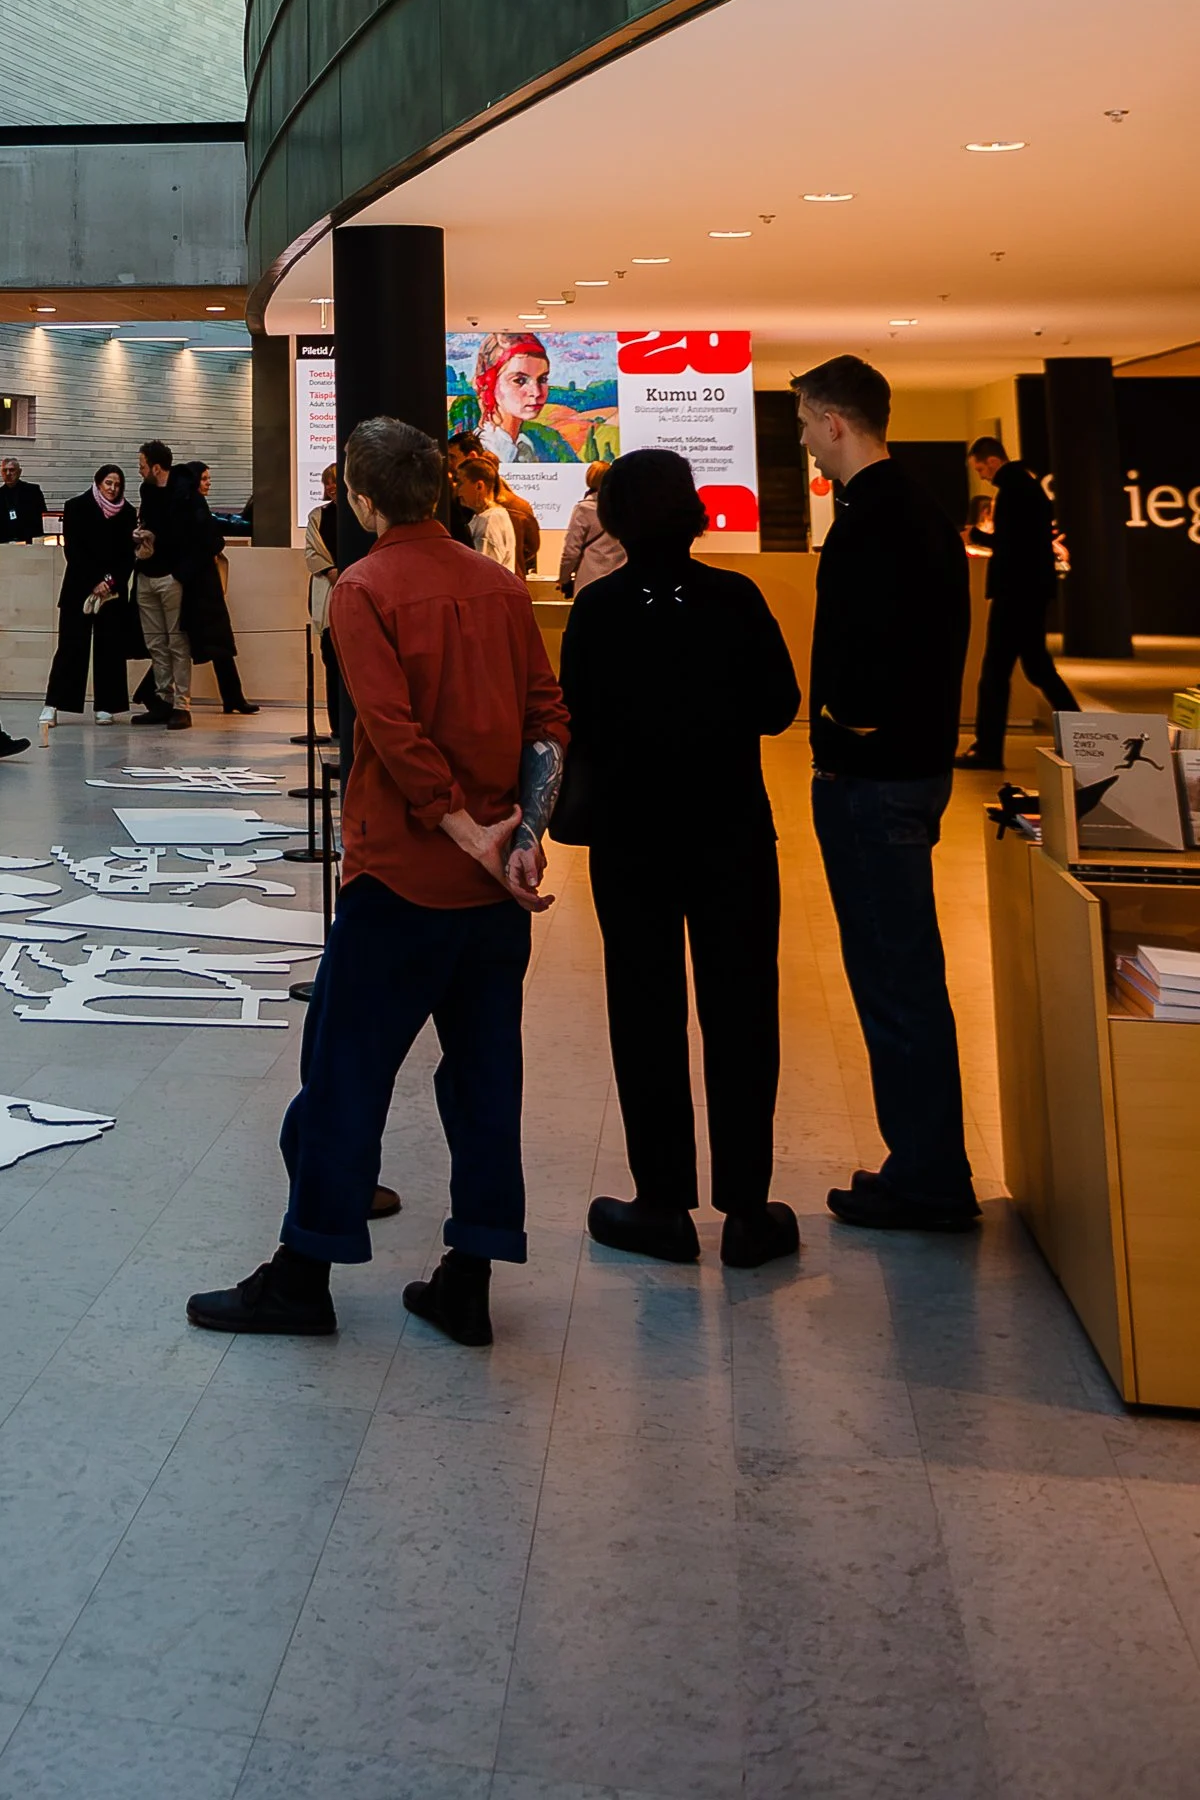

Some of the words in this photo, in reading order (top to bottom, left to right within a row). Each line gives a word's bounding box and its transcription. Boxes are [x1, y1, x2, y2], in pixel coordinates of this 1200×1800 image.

[302, 346, 328, 355] Piletid
[328, 346, 335, 357] /
[309, 370, 337, 380] Toetaj
[646, 388, 697, 401] Kumu
[703, 388, 725, 401] 20
[634, 405, 679, 414] Sünnipäev
[687, 405, 738, 415] Anniversary
